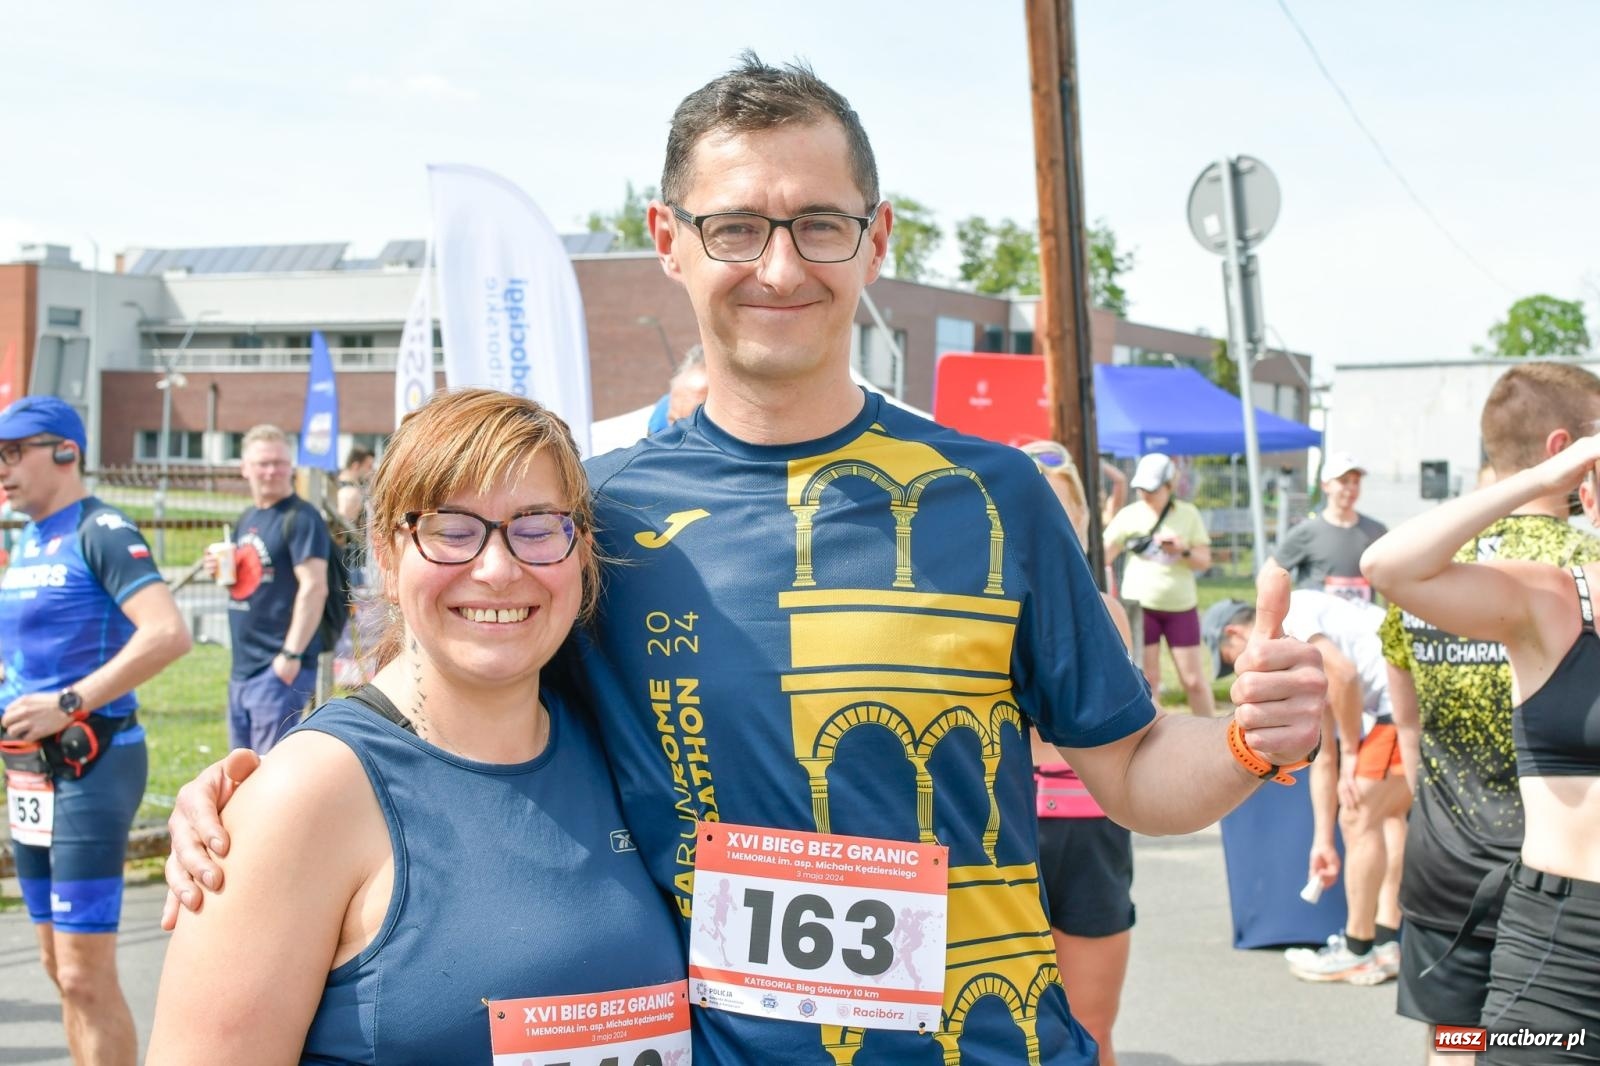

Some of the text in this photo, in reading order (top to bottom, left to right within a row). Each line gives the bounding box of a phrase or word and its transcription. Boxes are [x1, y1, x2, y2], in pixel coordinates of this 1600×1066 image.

[646, 611, 670, 656] 20
[675, 611, 699, 653] 24
[726, 831, 920, 866] XVI BIEG BEZ GRANIC
[732, 852, 777, 864] MEMORIAŁ
[778, 856, 792, 866] im.
[794, 860, 813, 870] asp.
[815, 860, 853, 872] Michała
[855, 864, 917, 880] Kędzierskiego
[802, 872, 823, 881] maja
[825, 872, 844, 882] 2024
[743, 887, 896, 976] 163
[744, 977, 880, 999] KATEGORIA: Bieg Główny 10 km
[523, 993, 675, 1024] XVI BIEG BEZ GRANIC
[853, 1005, 904, 1020] Racibórz
[531, 1024, 576, 1037] MEMORIAŁ
[576, 1022, 589, 1033] im.
[590, 1022, 605, 1033] asp.
[606, 1017, 633, 1029] Michała
[633, 1012, 674, 1026] Kędzierskiego
[597, 1033, 612, 1042] maja
[613, 1030, 627, 1039] 2024
